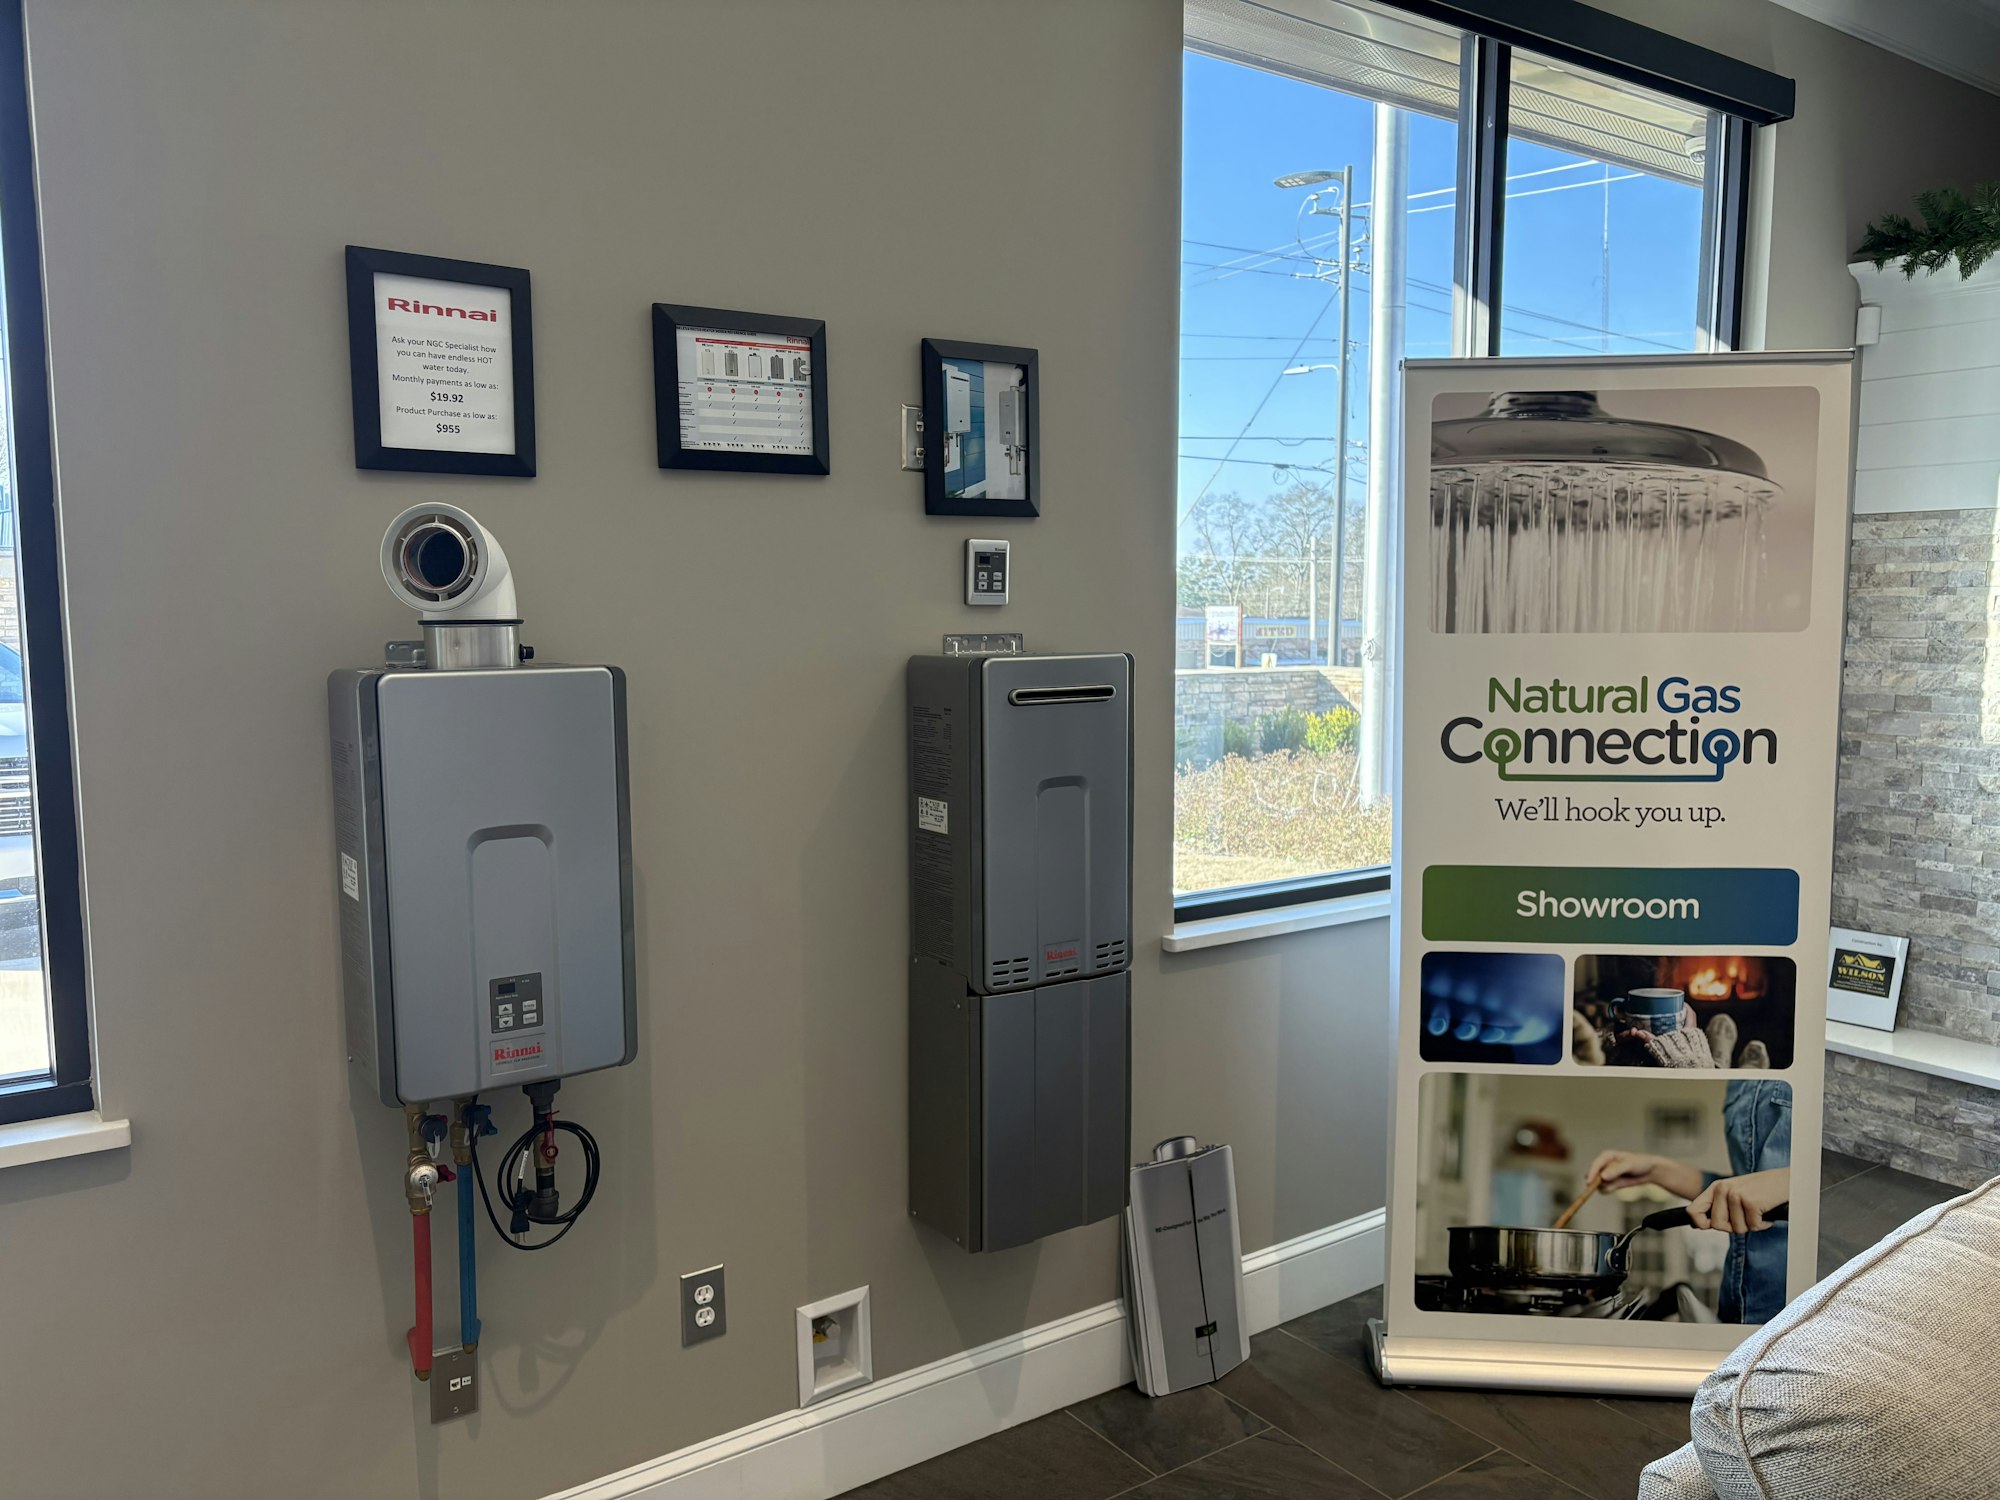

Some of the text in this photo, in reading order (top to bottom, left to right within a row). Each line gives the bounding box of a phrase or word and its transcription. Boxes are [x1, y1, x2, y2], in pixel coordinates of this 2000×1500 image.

[388, 297, 497, 322] Rinnai
[445, 342, 479, 351] Specialist
[481, 345, 496, 353] how
[428, 352, 446, 360] have
[448, 354, 475, 362] endless
[446, 365, 469, 374] today.
[392, 374, 424, 384] Monthly
[427, 378, 462, 387] payments
[474, 381, 487, 389] low
[430, 391, 464, 403] $19.92
[396, 406, 426, 415] Product
[428, 409, 461, 418] Purchase
[436, 423, 460, 434] $955
[1488, 675, 1741, 714] Natural Gas
[1440, 716, 1778, 766] Connection
[1494, 796, 1726, 828] We’ll hook you up.
[1516, 890, 1699, 919] Showroom
[1838, 966, 1885, 981] WILSON
[495, 1041, 541, 1061] Rinnai
